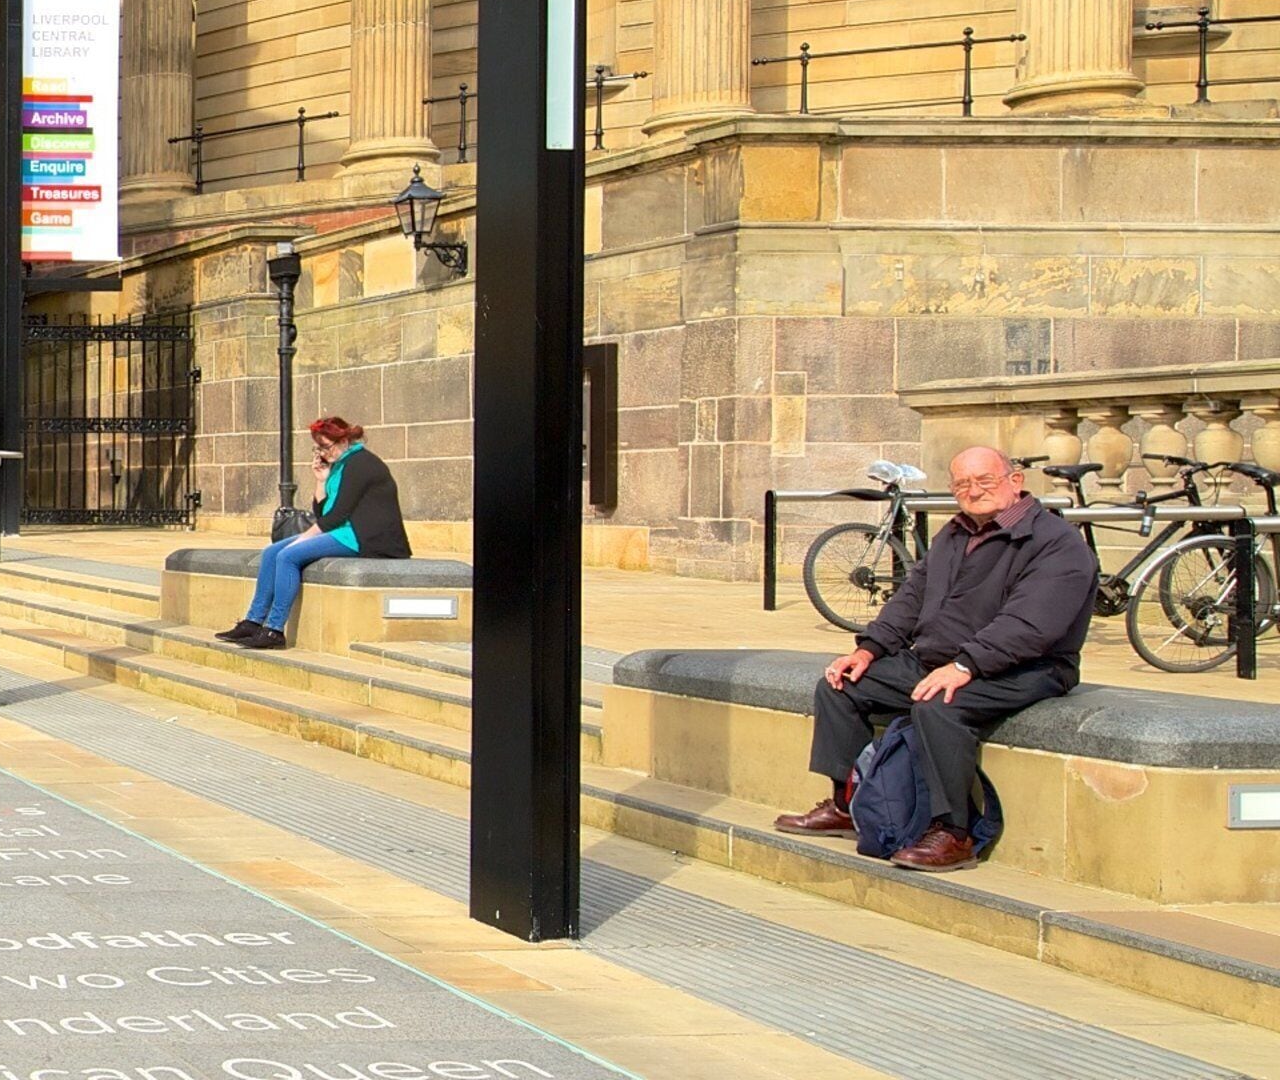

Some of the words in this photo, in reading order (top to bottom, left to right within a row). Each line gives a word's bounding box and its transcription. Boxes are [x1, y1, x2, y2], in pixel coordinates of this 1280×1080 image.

[32, 14, 109, 25] LIVERPOOL
[32, 30, 95, 41] CENTRAL
[32, 46, 90, 58] LIBRARY
[31, 112, 85, 125] Archive
[30, 160, 84, 176] Enquire
[30, 187, 99, 200] Treasures
[30, 212, 71, 224] Game
[145, 966, 378, 986] Cities
[222, 1058, 554, 1080] Queen
